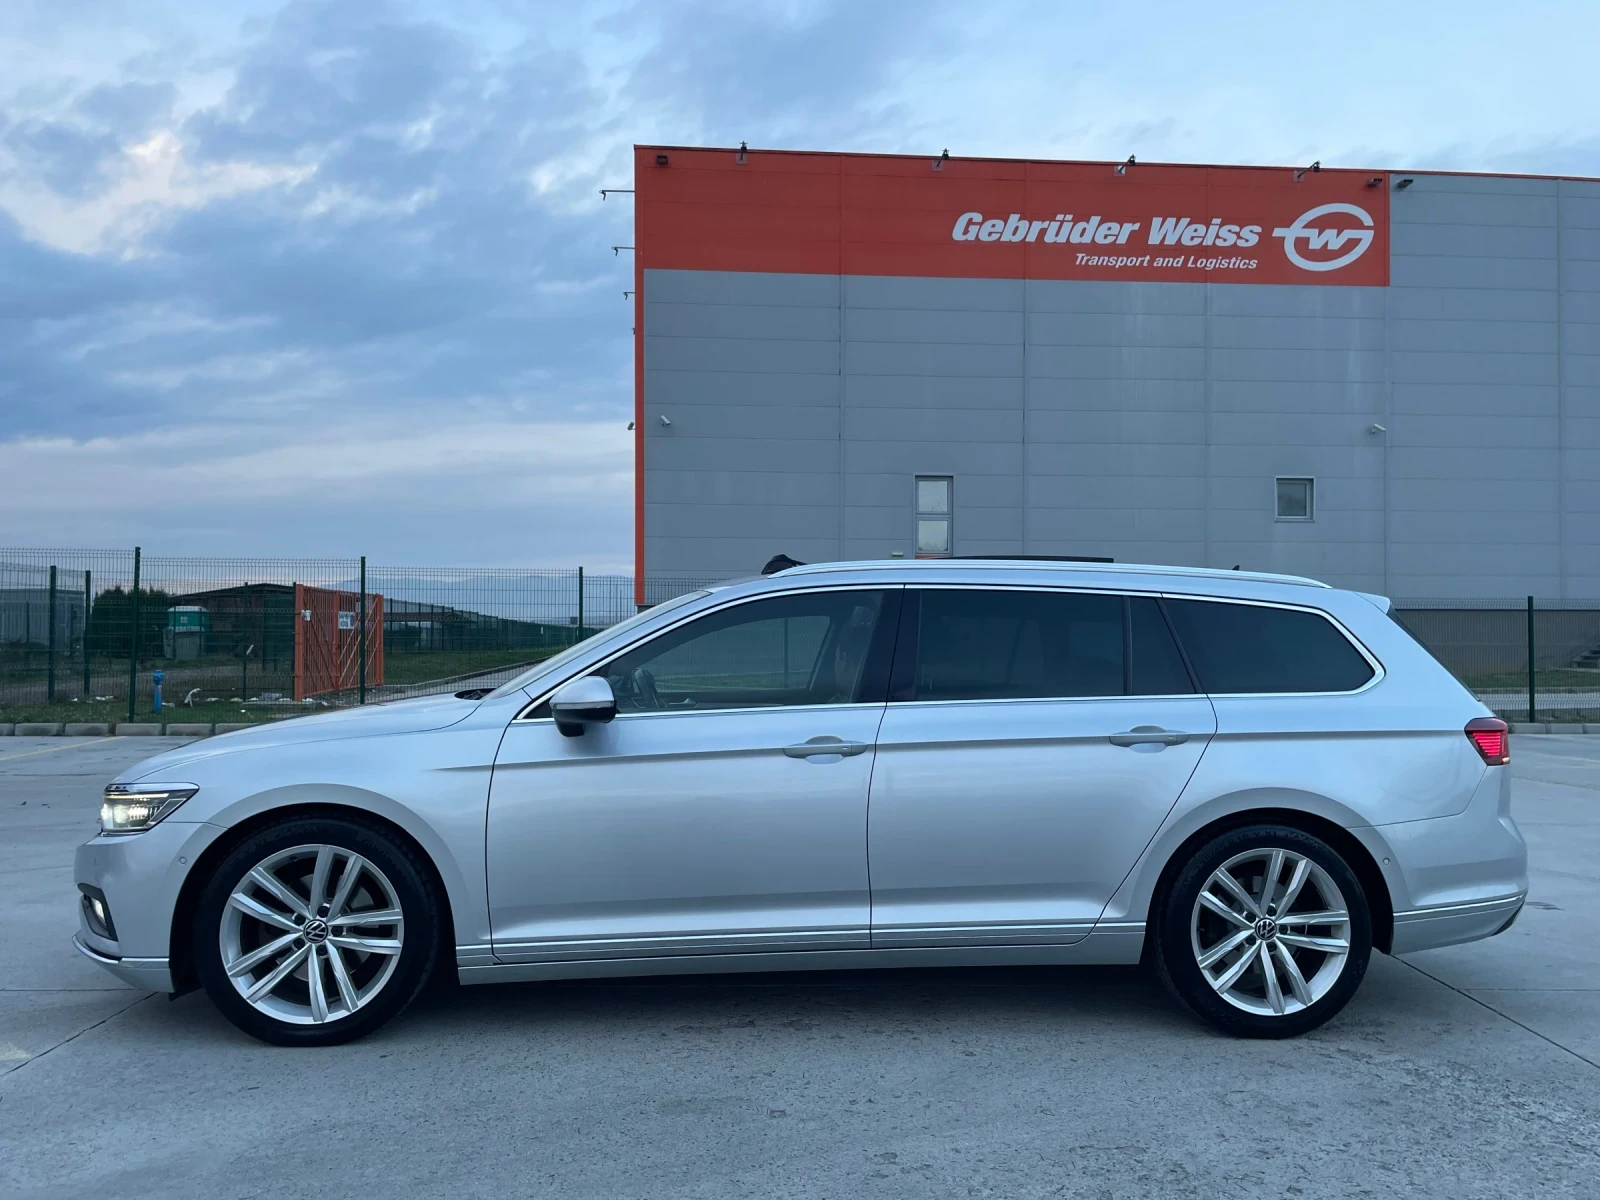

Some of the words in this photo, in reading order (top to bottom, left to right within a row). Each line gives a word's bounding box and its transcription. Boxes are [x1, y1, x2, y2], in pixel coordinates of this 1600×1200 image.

[952, 212, 1140, 244] Gebrüder
[1148, 217, 1262, 247] Weiss
[1075, 253, 1150, 268] Transport
[1153, 255, 1184, 267] and
[1187, 256, 1258, 271] Logistics
